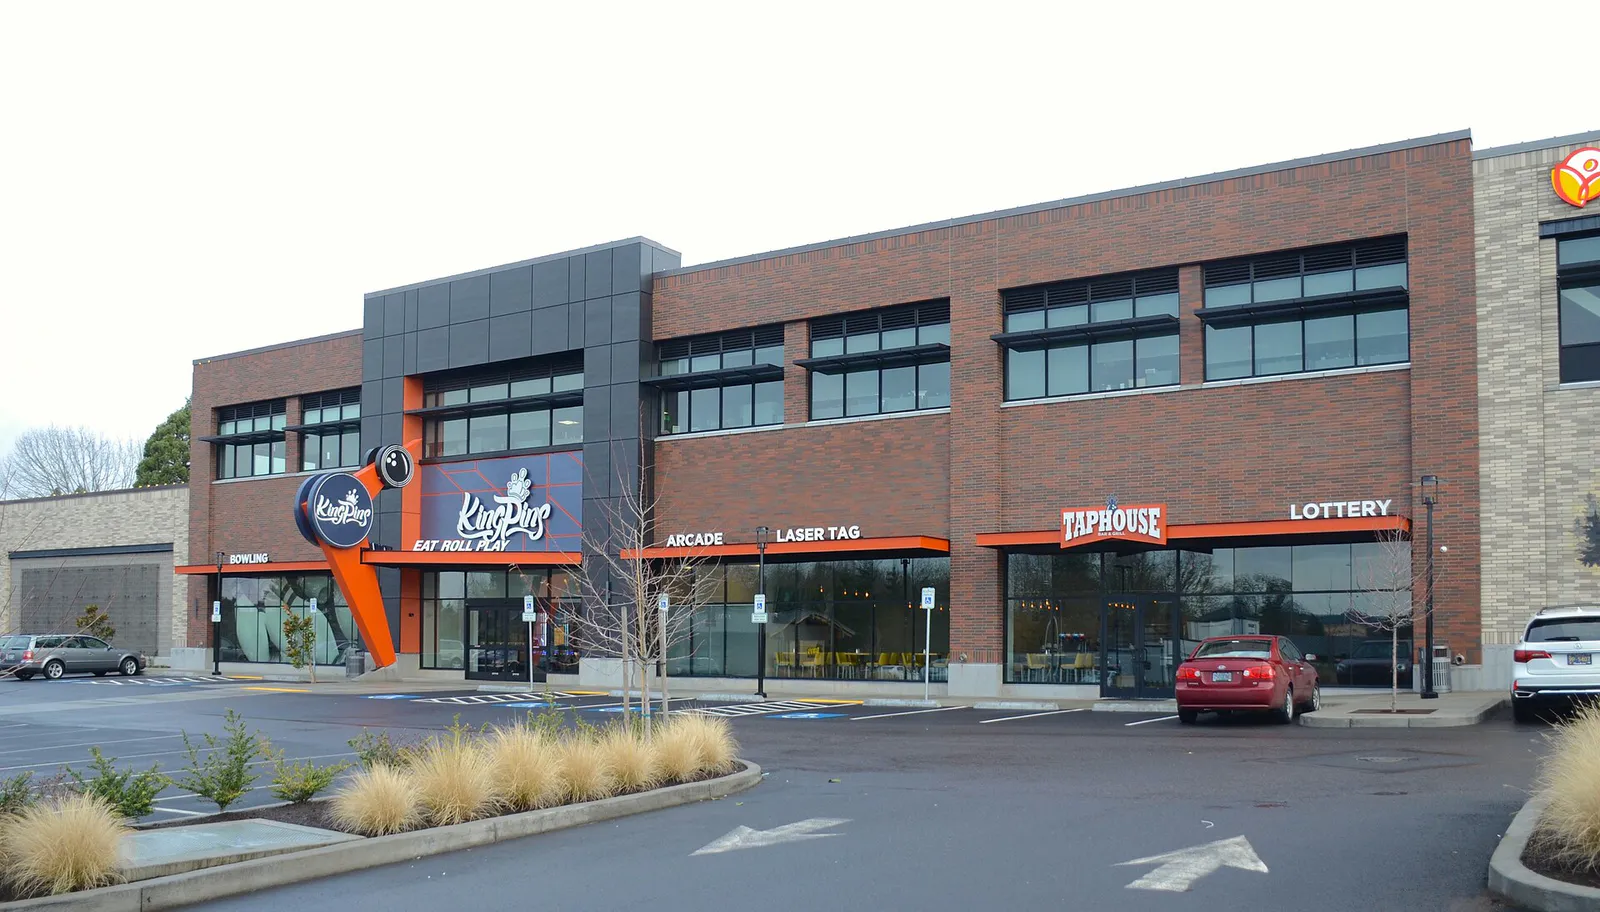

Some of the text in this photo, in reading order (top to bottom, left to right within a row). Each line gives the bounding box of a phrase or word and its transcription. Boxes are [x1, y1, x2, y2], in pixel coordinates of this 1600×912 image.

[316, 494, 371, 527] KingPins
[456, 491, 552, 542] KingPins
[1290, 499, 1392, 520] LOTTERY
[776, 525, 861, 543] LASER TAG
[1063, 507, 1161, 542] TAPHOUSE
[412, 538, 511, 552] EAT ROLL PLAY
[666, 532, 724, 548] ARCADE
[230, 552, 269, 565] BOWLING
